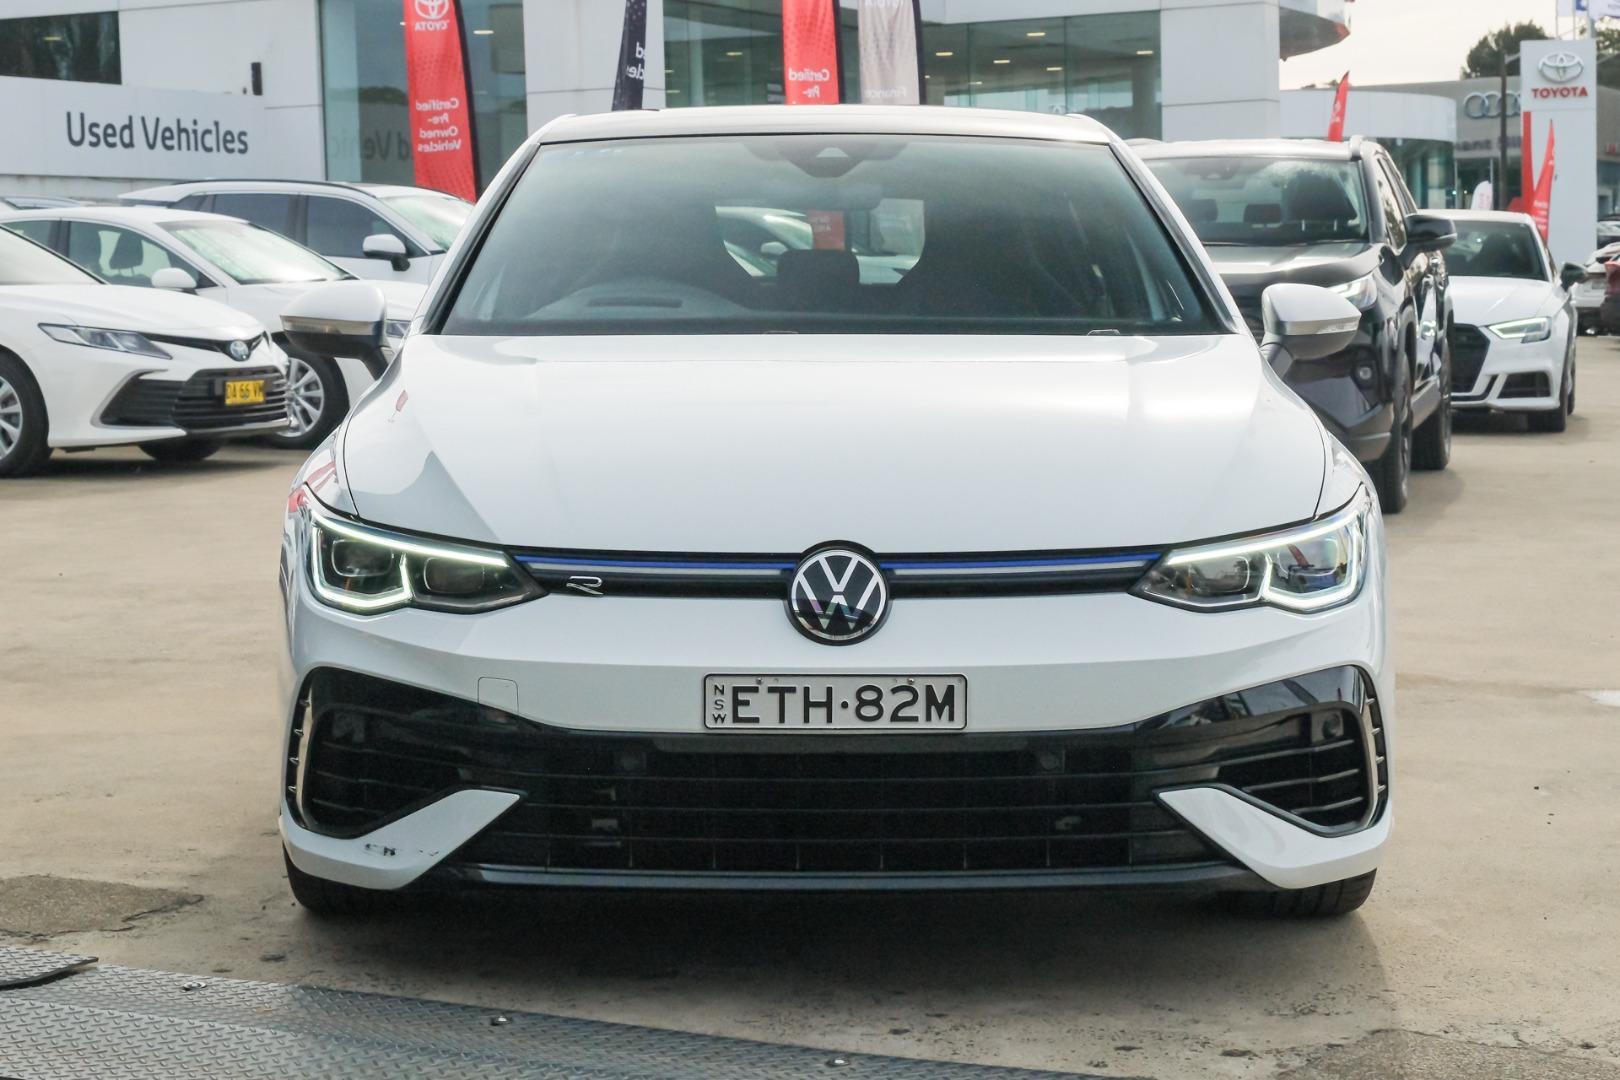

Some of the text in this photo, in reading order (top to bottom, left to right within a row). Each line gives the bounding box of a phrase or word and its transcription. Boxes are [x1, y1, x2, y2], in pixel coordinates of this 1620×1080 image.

[1531, 86, 1589, 99] TOYOTA
[66, 111, 249, 155] Used Vehicles
